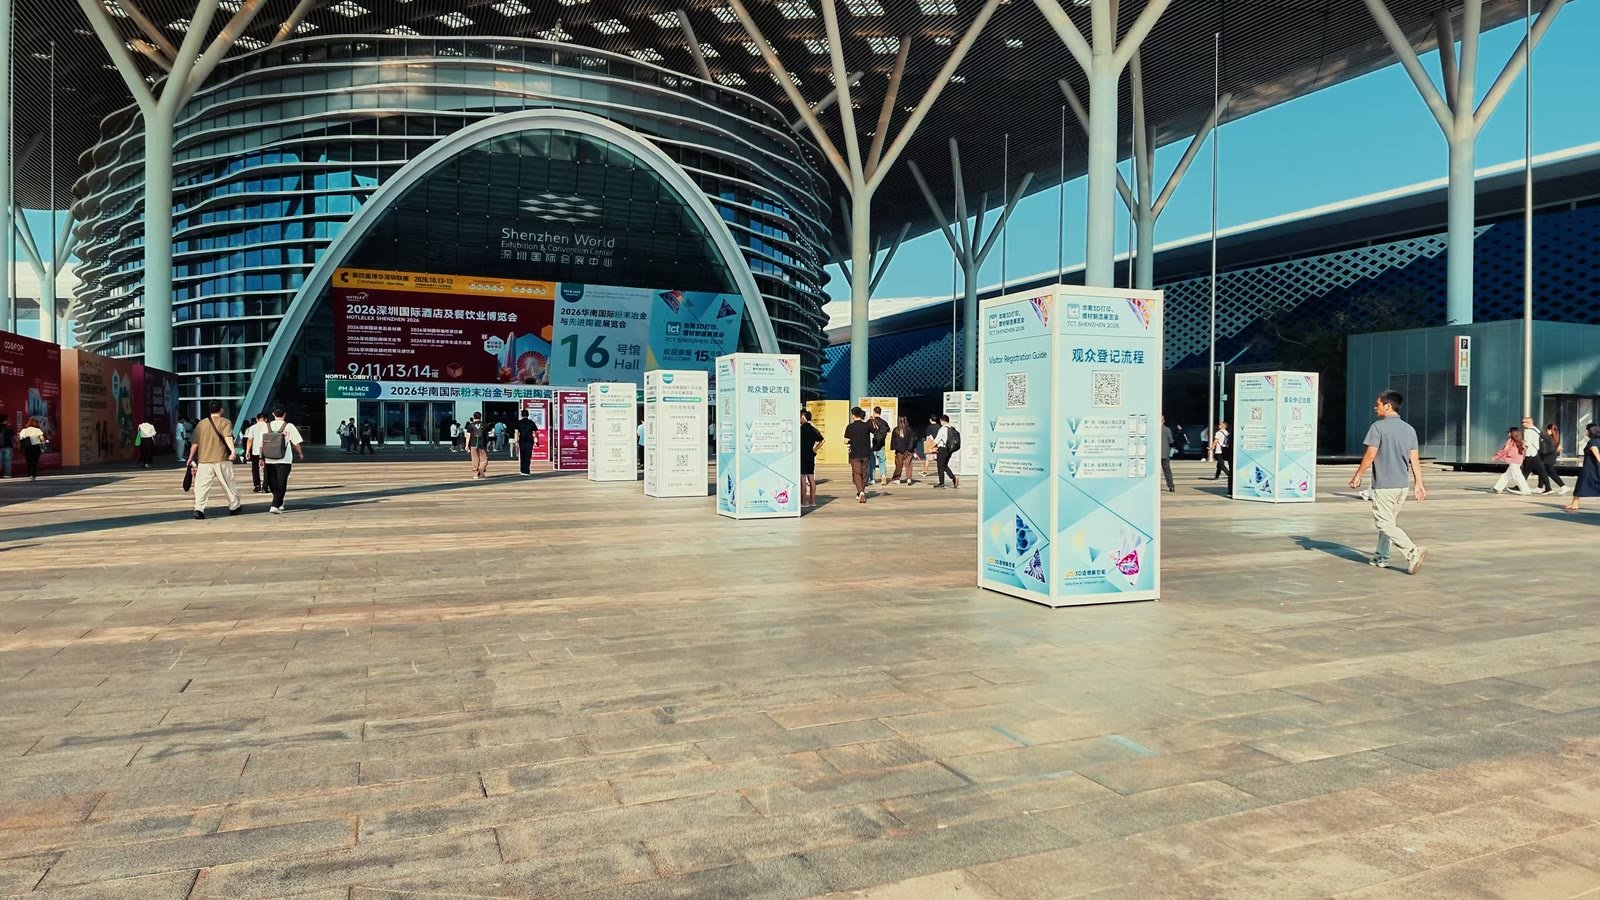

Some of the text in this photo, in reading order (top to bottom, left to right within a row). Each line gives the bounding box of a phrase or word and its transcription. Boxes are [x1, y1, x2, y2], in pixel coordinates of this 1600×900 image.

[501, 228, 615, 248] Shenzhen World
[501, 240, 538, 250] Exhibition
[548, 245, 589, 255] Convention
[590, 249, 614, 257] Center
[501, 250, 613, 267] 深圳国际会展中心
[346, 304, 518, 322] 2026深圳国际酒店及餐饮业博览会
[560, 308, 647, 320] 2026华南国际粉末冶金
[559, 317, 627, 329] 与先进陶瓷展览会
[667, 323, 680, 333] tct
[560, 333, 641, 369] 16 号馆
[1462, 339, 1467, 349] P
[663, 348, 692, 356] 欢迎参观
[694, 350, 709, 362] 15
[988, 350, 1048, 364] Visitor Registration Guide
[1071, 348, 1145, 364] 观众登记流程
[1460, 351, 1469, 368] H
[614, 359, 640, 370] Hall
[747, 385, 790, 394] 观众登记流程
